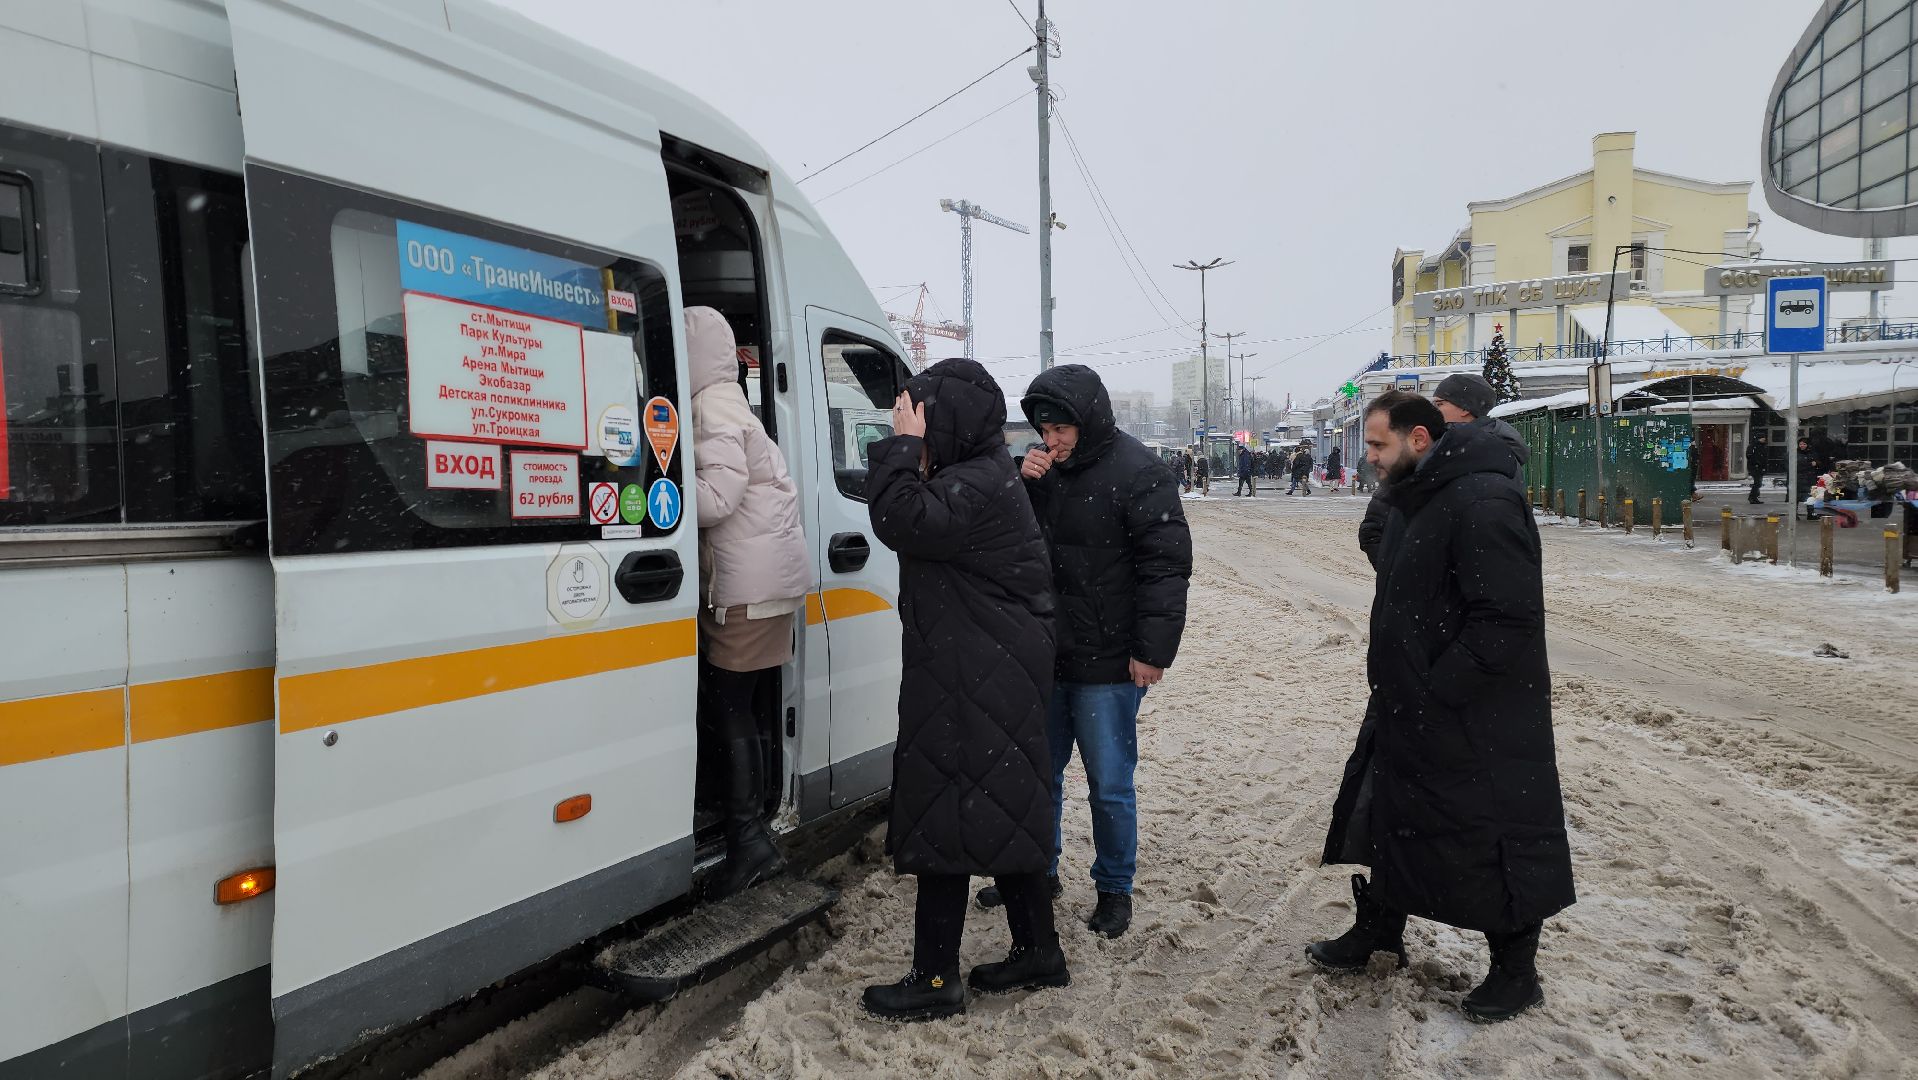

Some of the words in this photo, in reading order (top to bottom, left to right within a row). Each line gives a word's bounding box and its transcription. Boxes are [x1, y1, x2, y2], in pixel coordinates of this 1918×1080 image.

[407, 240, 455, 275] ООО
[461, 255, 600, 307] «ТрансИнвест»
[1720, 270, 1760, 288] ООО
[610, 295, 634, 309] ВХОД
[1432, 291, 1464, 312] ЗАО
[1473, 284, 1507, 307] ТПК
[1518, 281, 1544, 303] СБ
[1553, 277, 1601, 301] ЩИТ
[470, 312, 532, 332] ст.Мытищи
[460, 324, 490, 341] Парк
[491, 330, 543, 350] Культуры
[481, 345, 526, 362] ул.Мира
[462, 355, 497, 373] Арена
[500, 362, 545, 379] Мытищи
[479, 374, 531, 393] Экобазар
[439, 385, 487, 402] Детская
[471, 406, 540, 424] ул.Сукромка
[472, 421, 540, 439] ул.Троицкая
[435, 453, 495, 479] ВХОД
[523, 463, 568, 472] СТОИМОСТЬ
[528, 475, 563, 484] ПРОЕЗДА
[519, 492, 535, 505] 62
[538, 493, 574, 508] рубля
